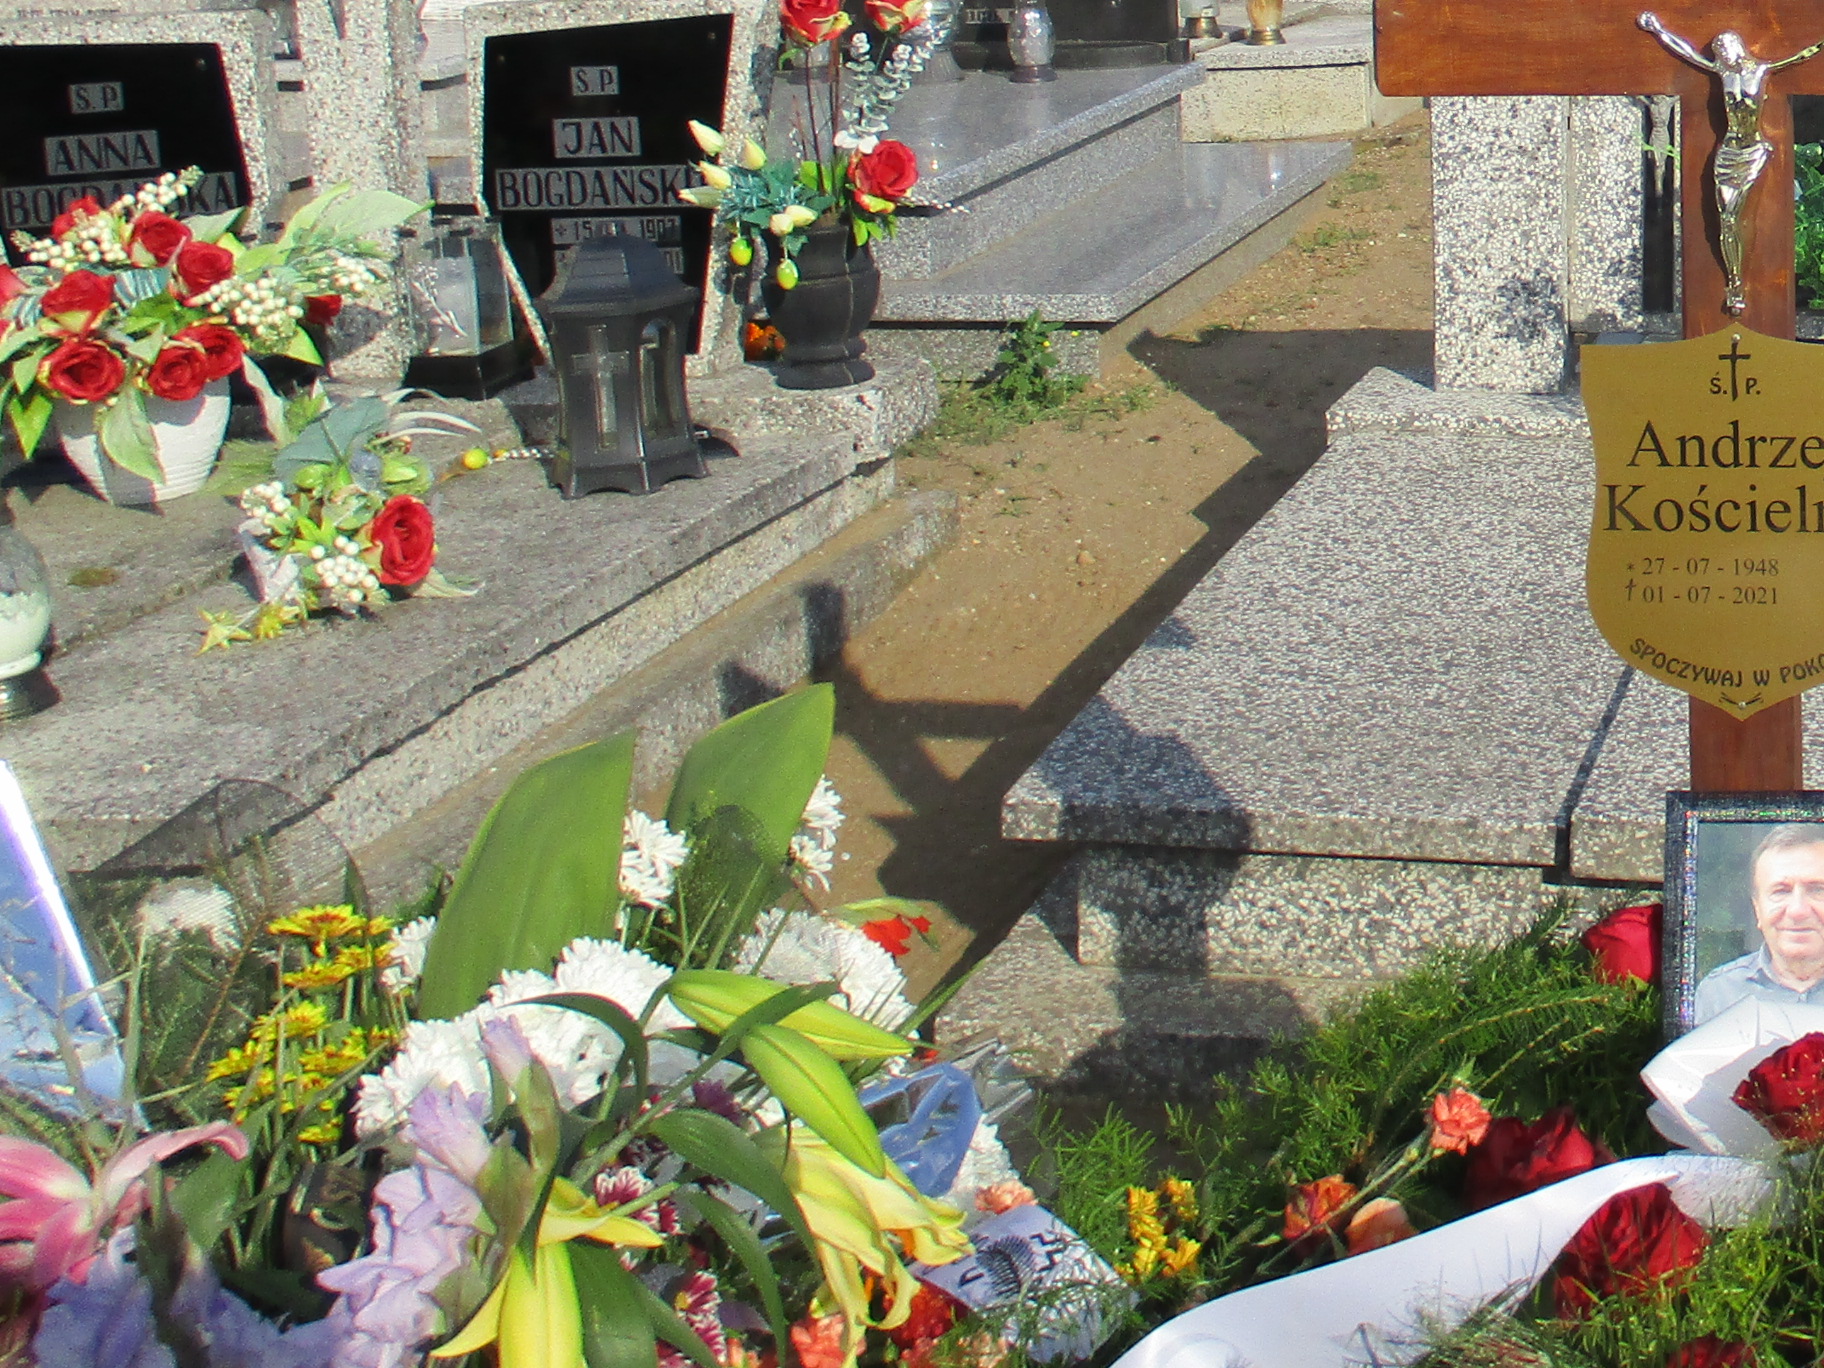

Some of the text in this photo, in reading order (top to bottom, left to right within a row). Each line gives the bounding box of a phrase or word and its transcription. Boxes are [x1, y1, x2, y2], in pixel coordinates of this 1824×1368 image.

[54, 133, 157, 172] ANNA
[562, 120, 634, 156] JAN
[1709, 371, 1761, 395] Ś. P.
[1642, 557, 1665, 576] 27
[1686, 557, 1710, 576] 07
[1732, 557, 1780, 576] 1948
[1642, 586, 1665, 605] 01
[1686, 586, 1710, 605] 07
[1732, 586, 1780, 605] 2021
[1629, 636, 1744, 688] SPOCZYWAJ
[1753, 671, 1771, 687] W
